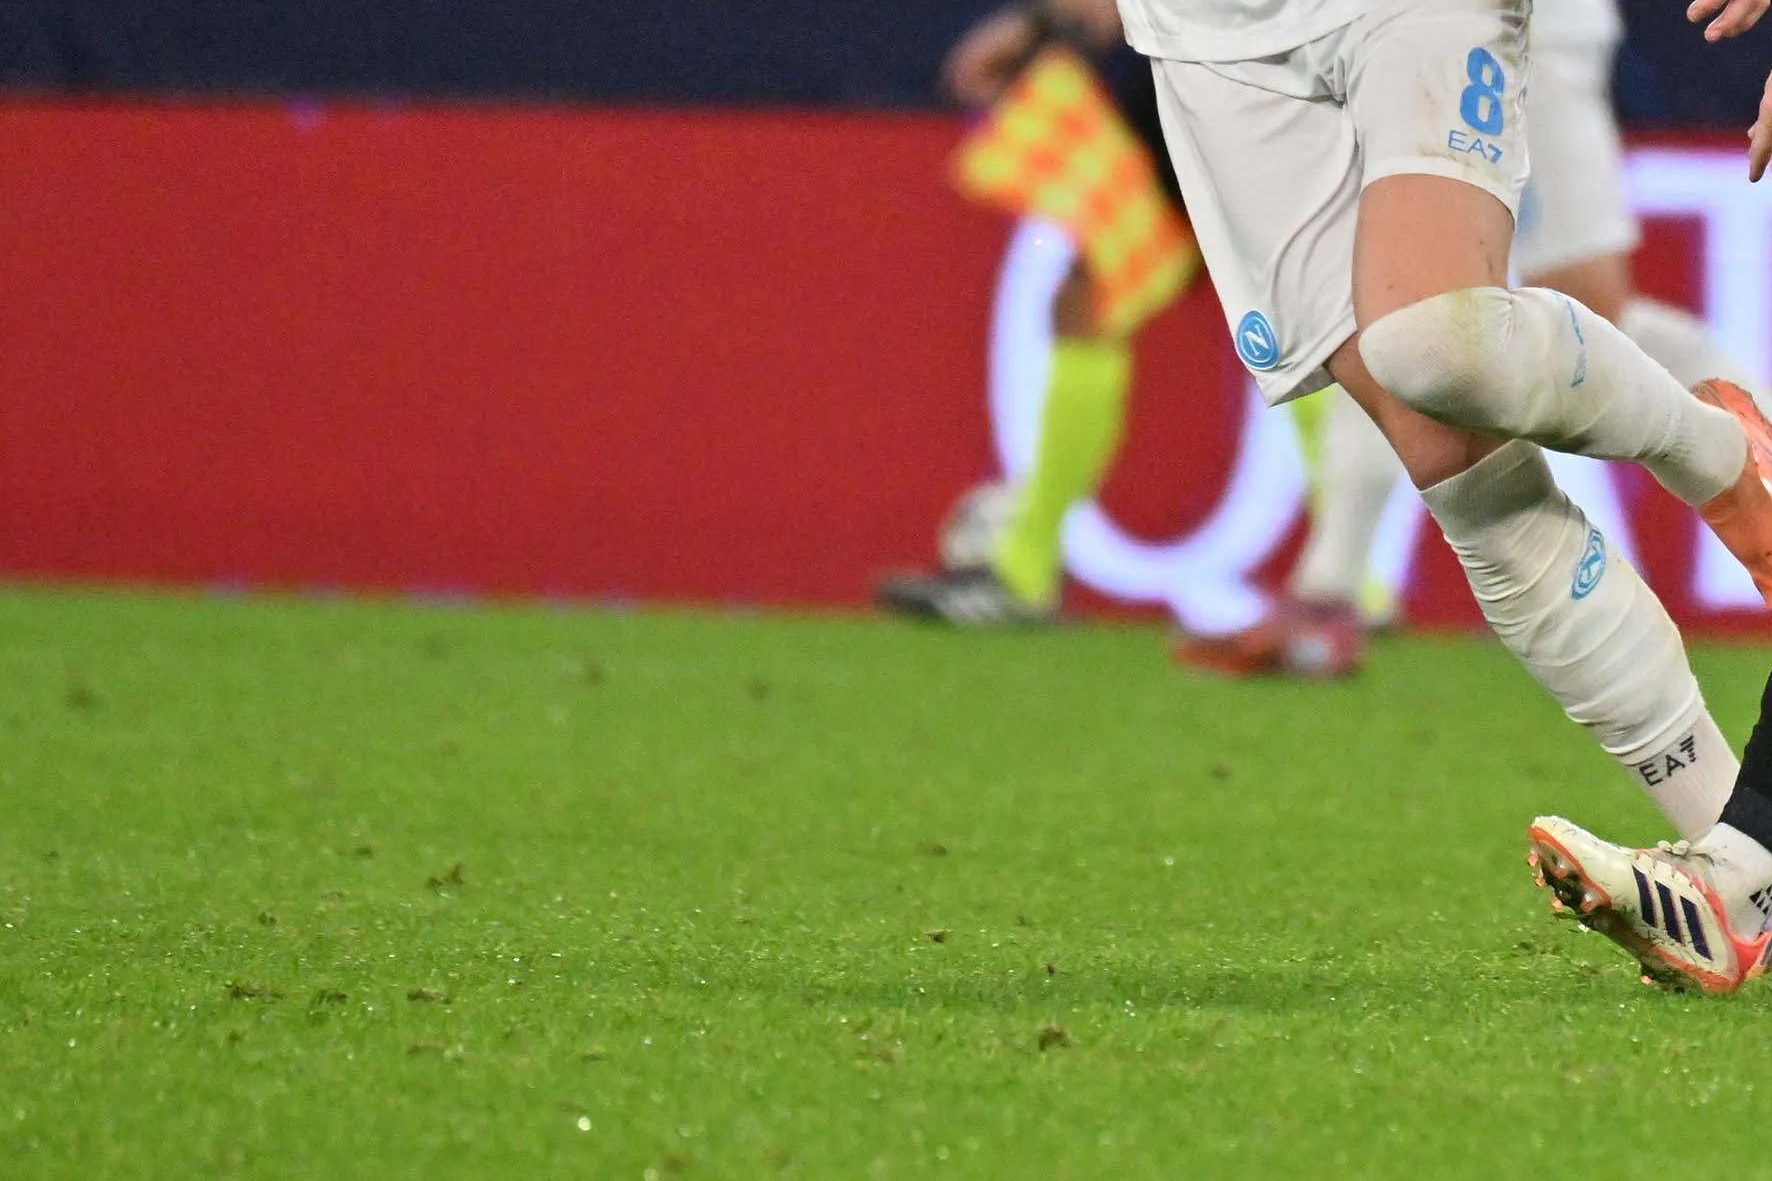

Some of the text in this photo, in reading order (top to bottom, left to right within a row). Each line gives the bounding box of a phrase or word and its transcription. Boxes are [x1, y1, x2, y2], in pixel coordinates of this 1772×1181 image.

[1460, 45, 1505, 136] 8
[1448, 129, 1503, 164] EA7
[1244, 323, 1269, 357] N
[1639, 735, 1696, 786] EA7
